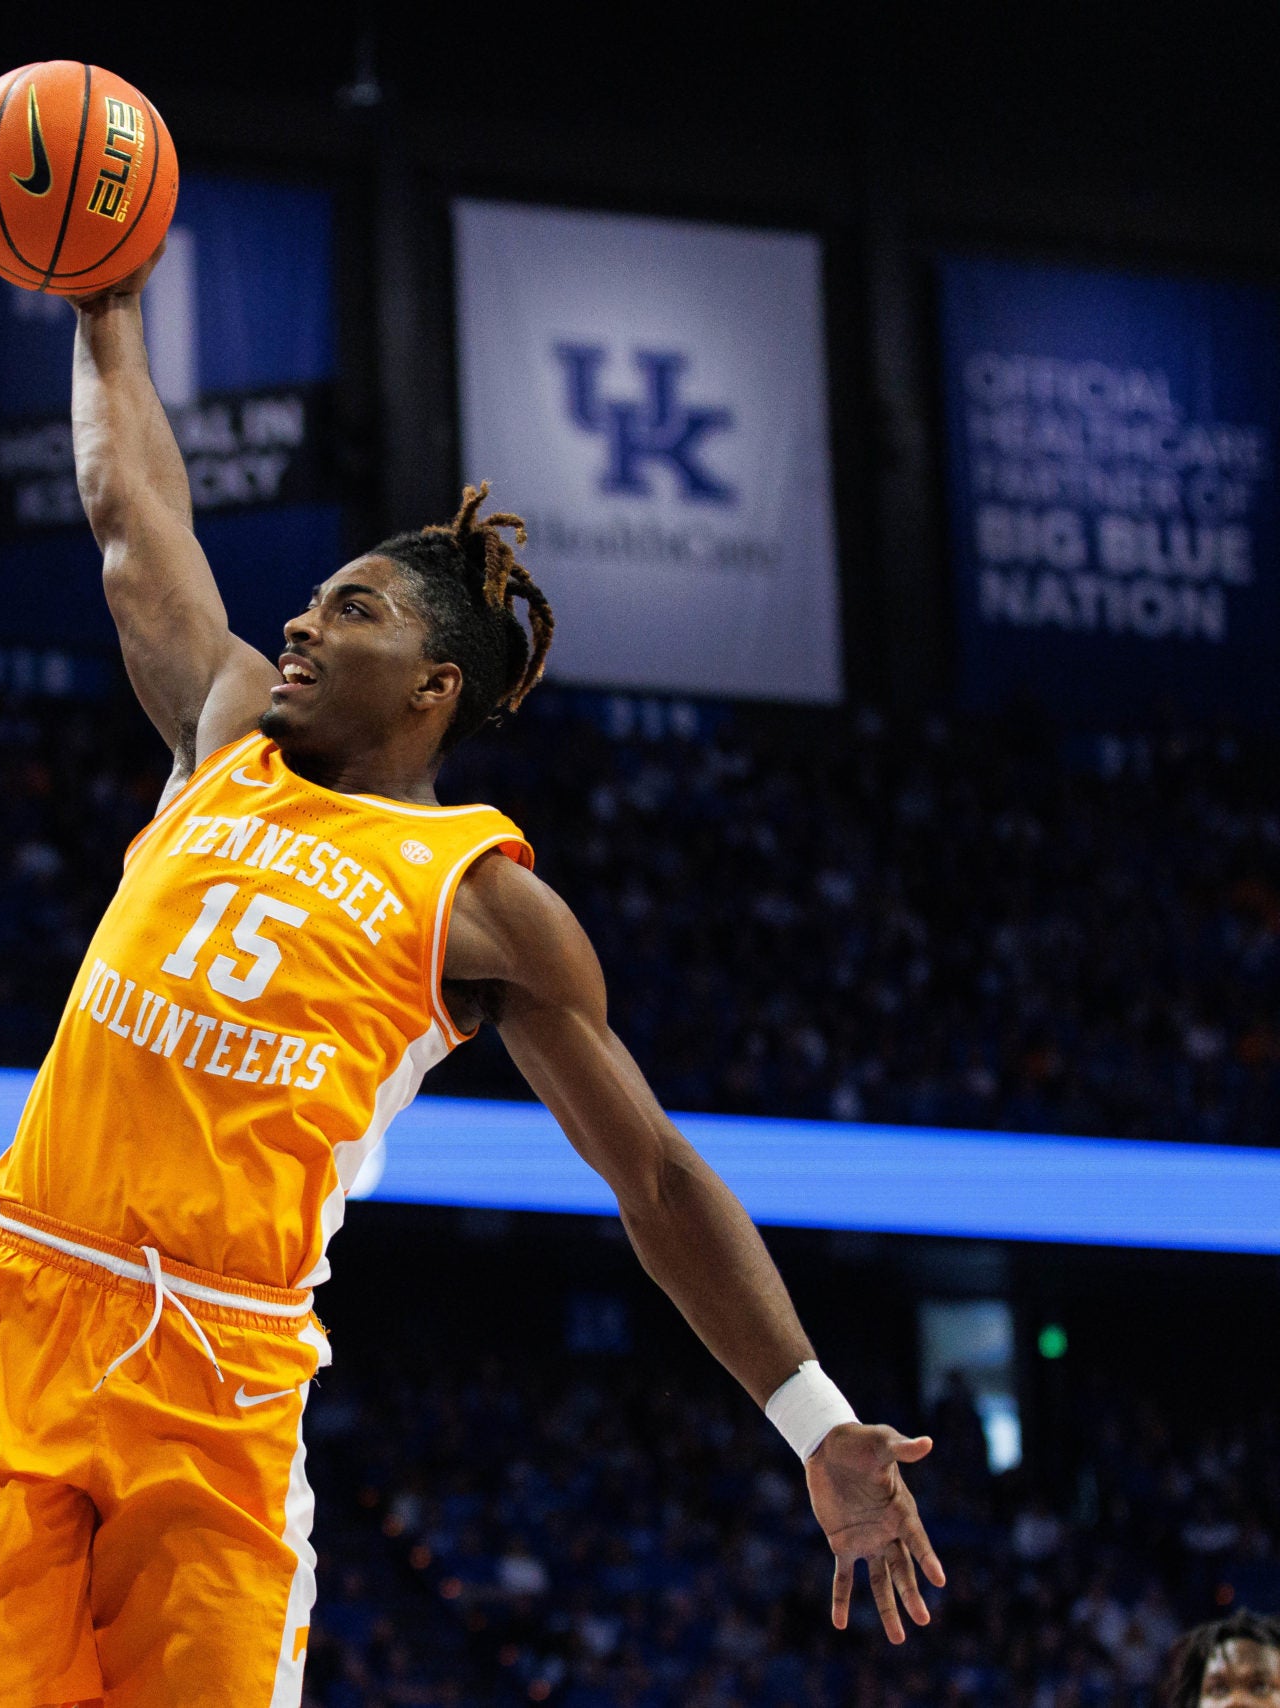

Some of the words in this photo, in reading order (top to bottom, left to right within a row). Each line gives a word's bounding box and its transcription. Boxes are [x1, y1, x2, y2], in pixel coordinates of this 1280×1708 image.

[87, 96, 137, 220] ELITE
[552, 341, 738, 506] UK
[976, 504, 1088, 568] BIG
[1099, 514, 1254, 588] BLUE
[978, 568, 1227, 644] NATION
[168, 815, 403, 945] TENNESSEE
[402, 842, 432, 862] SEC
[161, 882, 310, 1002] 15
[78, 958, 339, 1091] VOLUNTEERS
